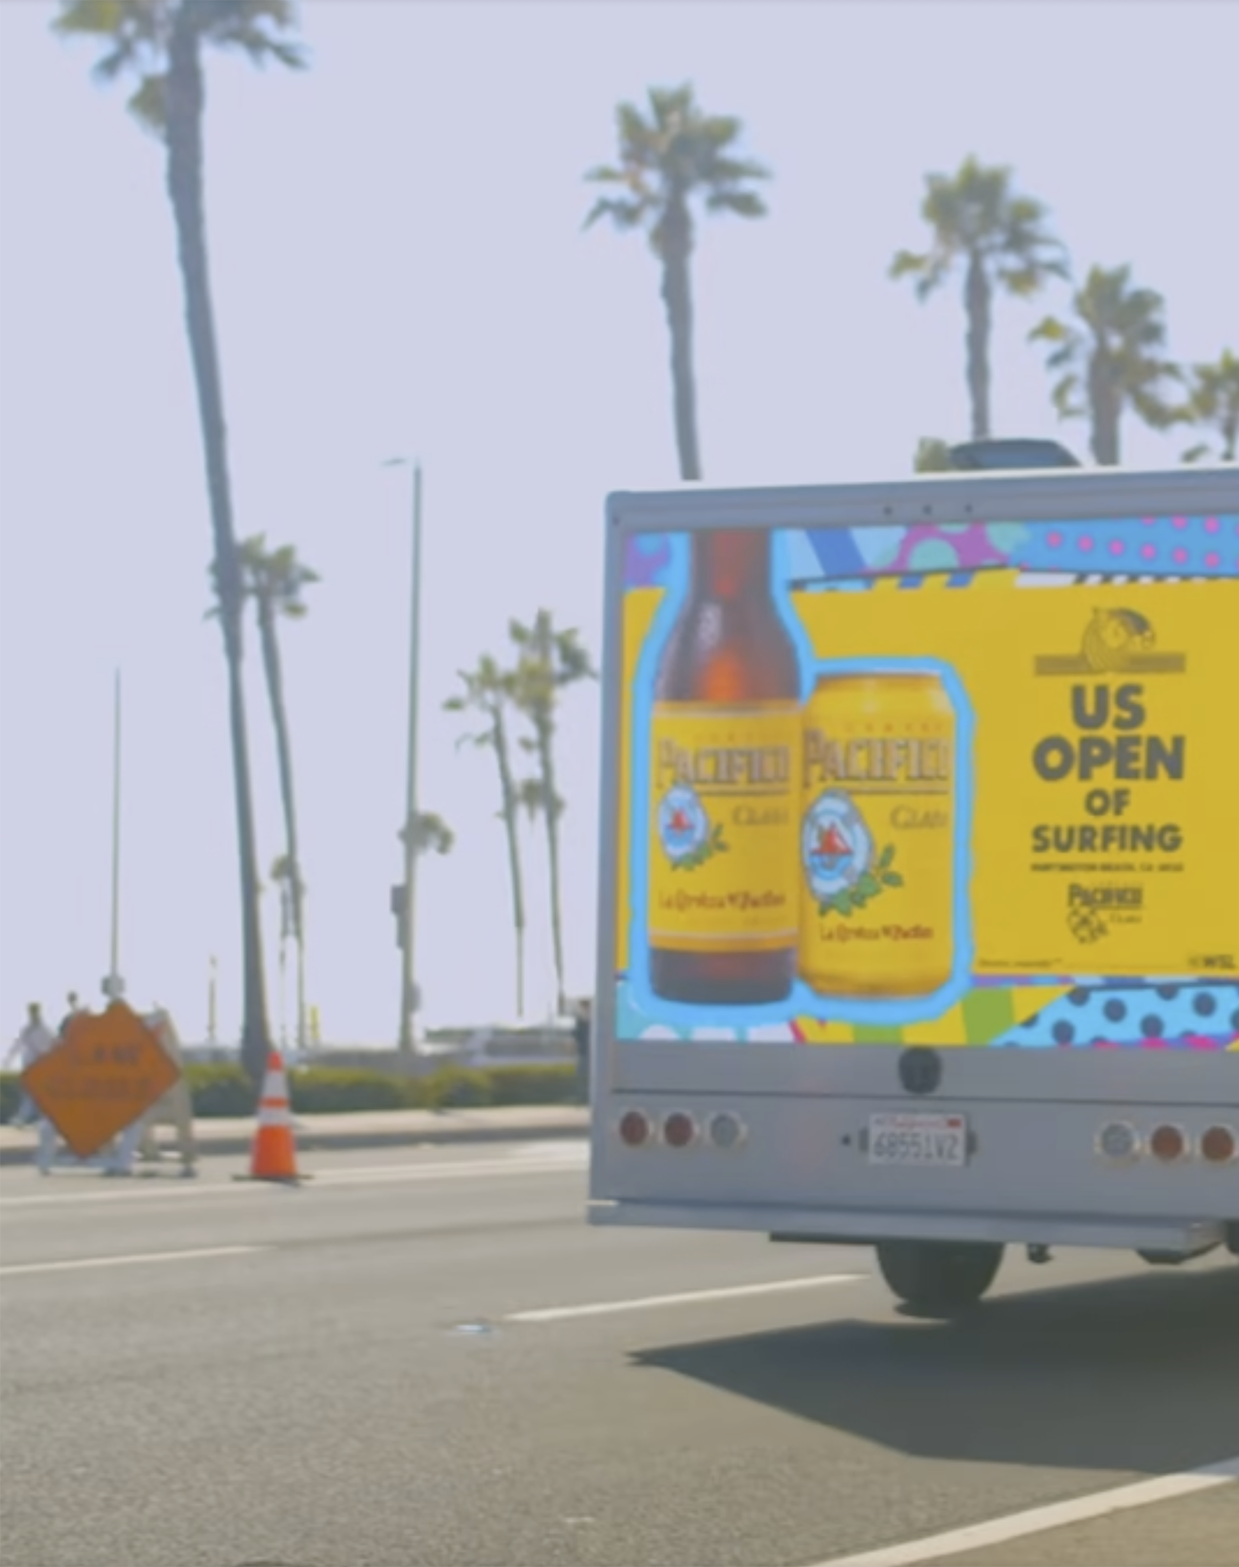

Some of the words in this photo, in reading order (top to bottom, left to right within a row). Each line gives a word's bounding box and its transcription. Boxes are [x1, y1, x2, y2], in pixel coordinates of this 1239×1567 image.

[1070, 683, 1147, 731] US
[1031, 734, 1186, 782] OPEN
[1084, 787, 1131, 816] OF
[1031, 823, 1184, 852] SURFING
